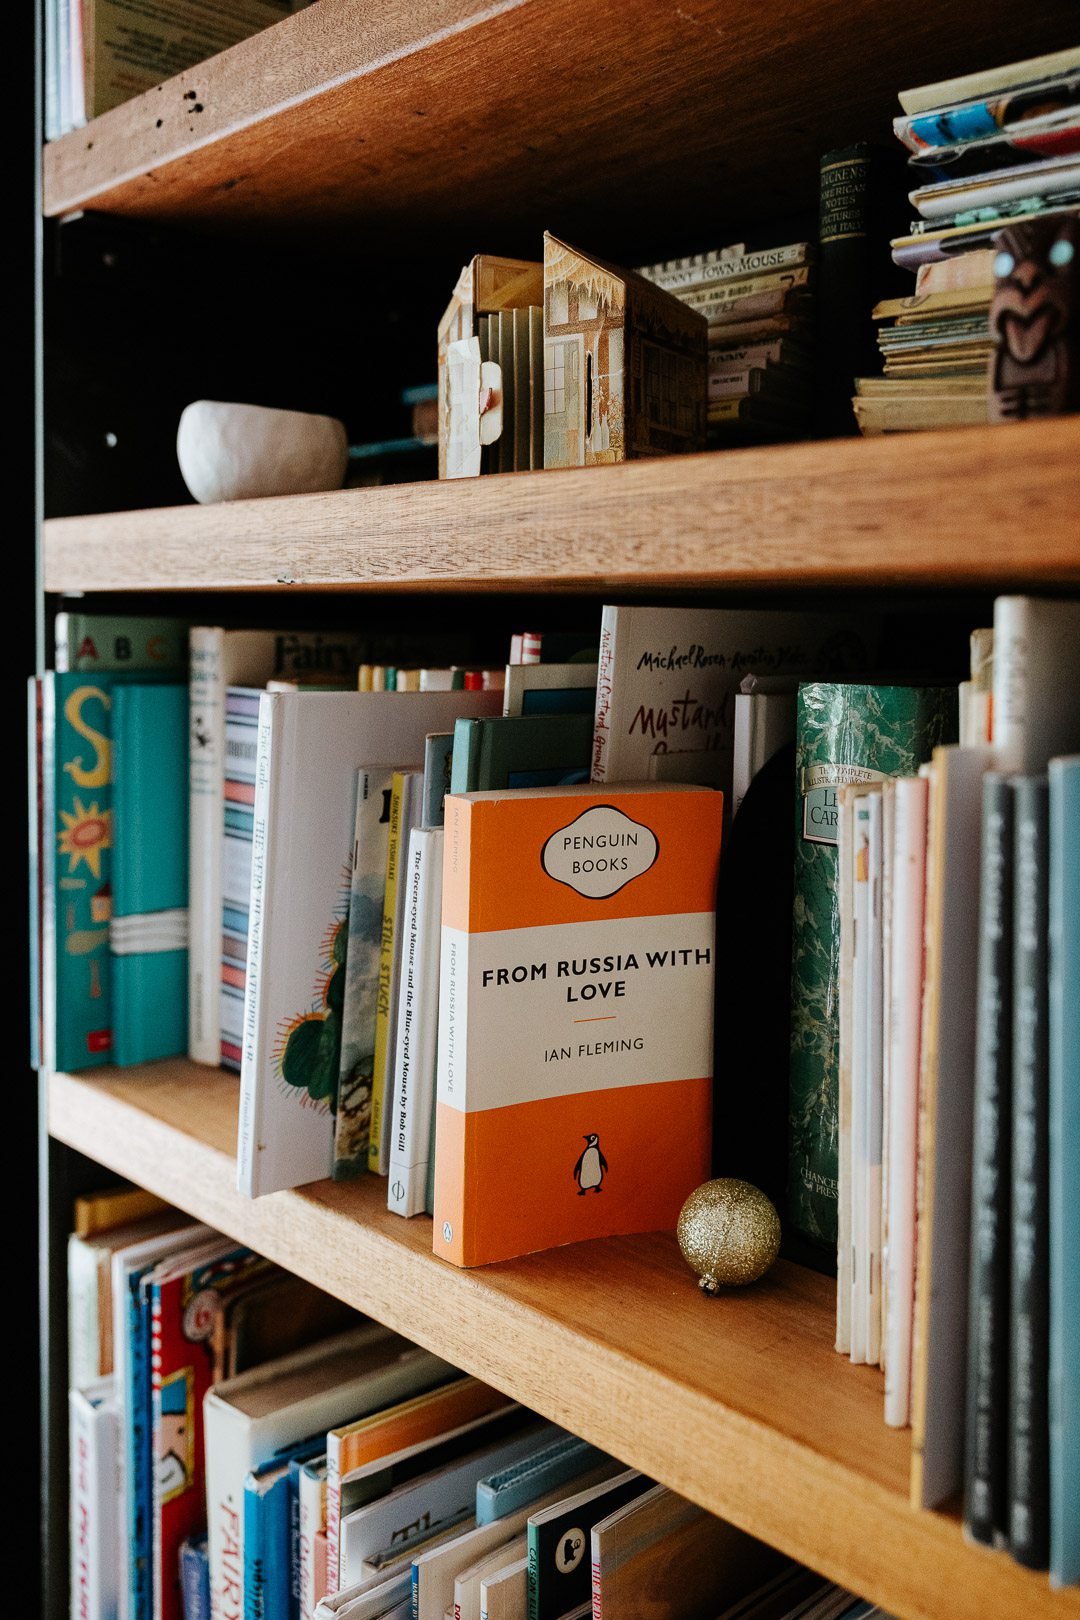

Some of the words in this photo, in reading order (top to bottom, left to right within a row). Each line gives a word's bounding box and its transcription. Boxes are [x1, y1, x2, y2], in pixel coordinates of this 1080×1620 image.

[820, 167, 867, 188] DICKENS
[825, 194, 856, 209] NOTES
[636, 644, 695, 671] Michael
[694, 646, 727, 668] Rosen
[261, 724, 272, 752] Eric
[258, 755, 270, 790] Carle
[592, 735, 607, 777] Grumble
[390, 793, 400, 834] SHINSUKE
[255, 818, 267, 850] THE
[563, 832, 639, 851] PENGUIN
[387, 838, 398, 881] YOSHITAKE
[414, 850, 423, 870] The
[452, 830, 460, 873] FLEMING
[572, 857, 628, 874] BOOKS
[252, 854, 265, 892] VERY
[410, 872, 422, 930] Green-eyed
[250, 897, 262, 960] HUNGRY
[380, 914, 394, 954] STILL
[408, 932, 418, 966] Mouse
[449, 942, 457, 977] FROM
[407, 967, 415, 989] and
[482, 962, 547, 988] FROM
[557, 953, 640, 978] RUSSIA
[645, 948, 712, 969] WITH
[377, 962, 391, 1019] STUCK
[406, 990, 414, 1007] the
[448, 979, 456, 1023] RUSSIA
[566, 980, 627, 1003] LOVE
[246, 961, 259, 1063] CATERPILLAR
[402, 1009, 413, 1060] Blue-eyed
[447, 1025, 455, 1059] WITH
[544, 1047, 571, 1063] IAN
[578, 1037, 645, 1058] FLEMING
[401, 1061, 410, 1095] Mouse
[399, 1095, 408, 1110] by
[398, 1111, 407, 1131] Bob
[398, 1132, 406, 1152] Gill
[529, 1547, 537, 1593] CARSON
[592, 1562, 602, 1588] THE
[592, 1591, 602, 1620] RED
